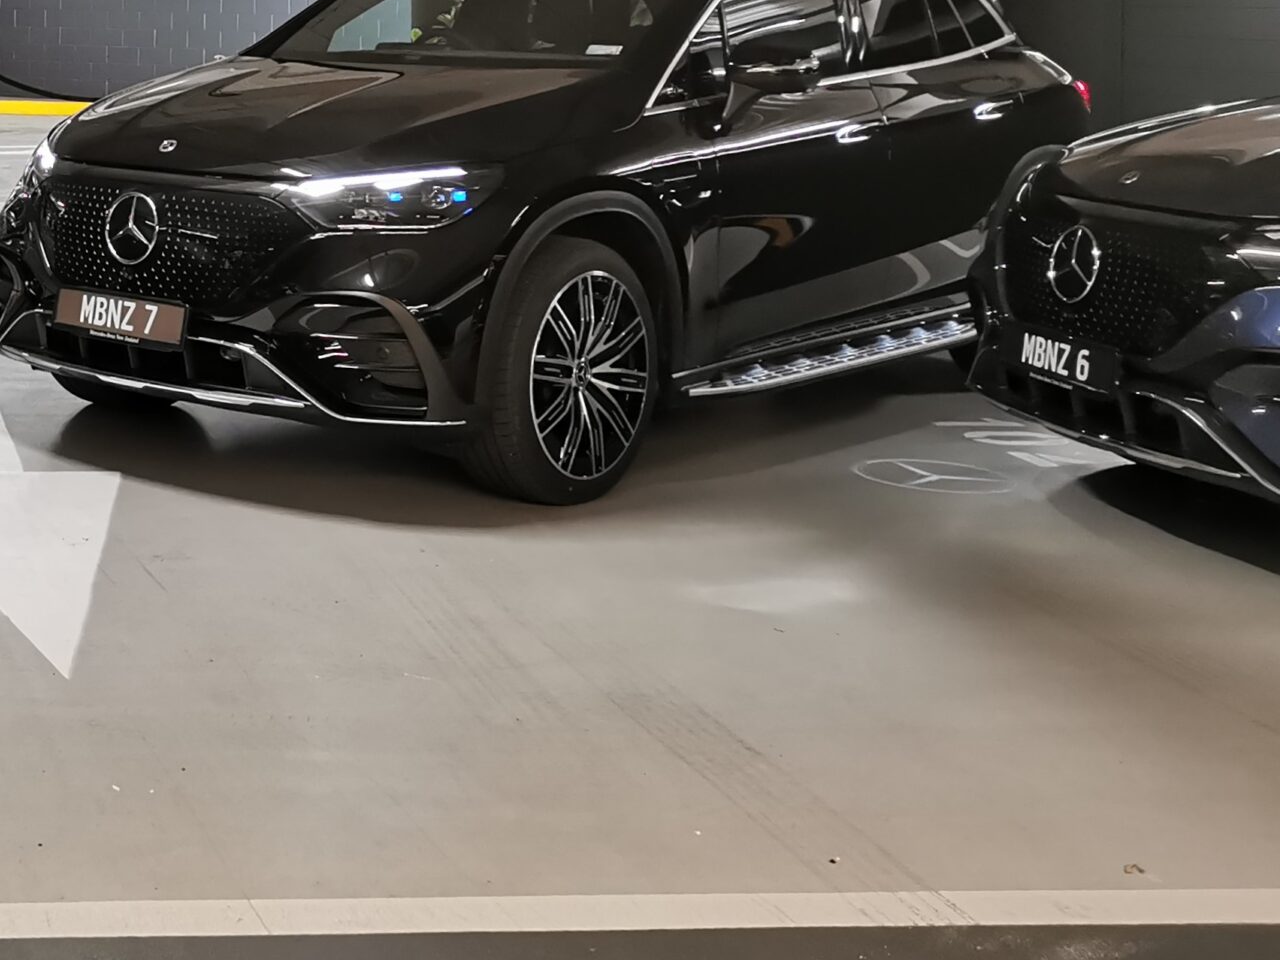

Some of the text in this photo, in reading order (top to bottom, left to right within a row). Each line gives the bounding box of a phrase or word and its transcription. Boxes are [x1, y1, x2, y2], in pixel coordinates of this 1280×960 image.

[80, 294, 158, 335] MBNZ 7
[1021, 332, 1071, 377] MBNZ
[1076, 349, 1090, 381] 6
